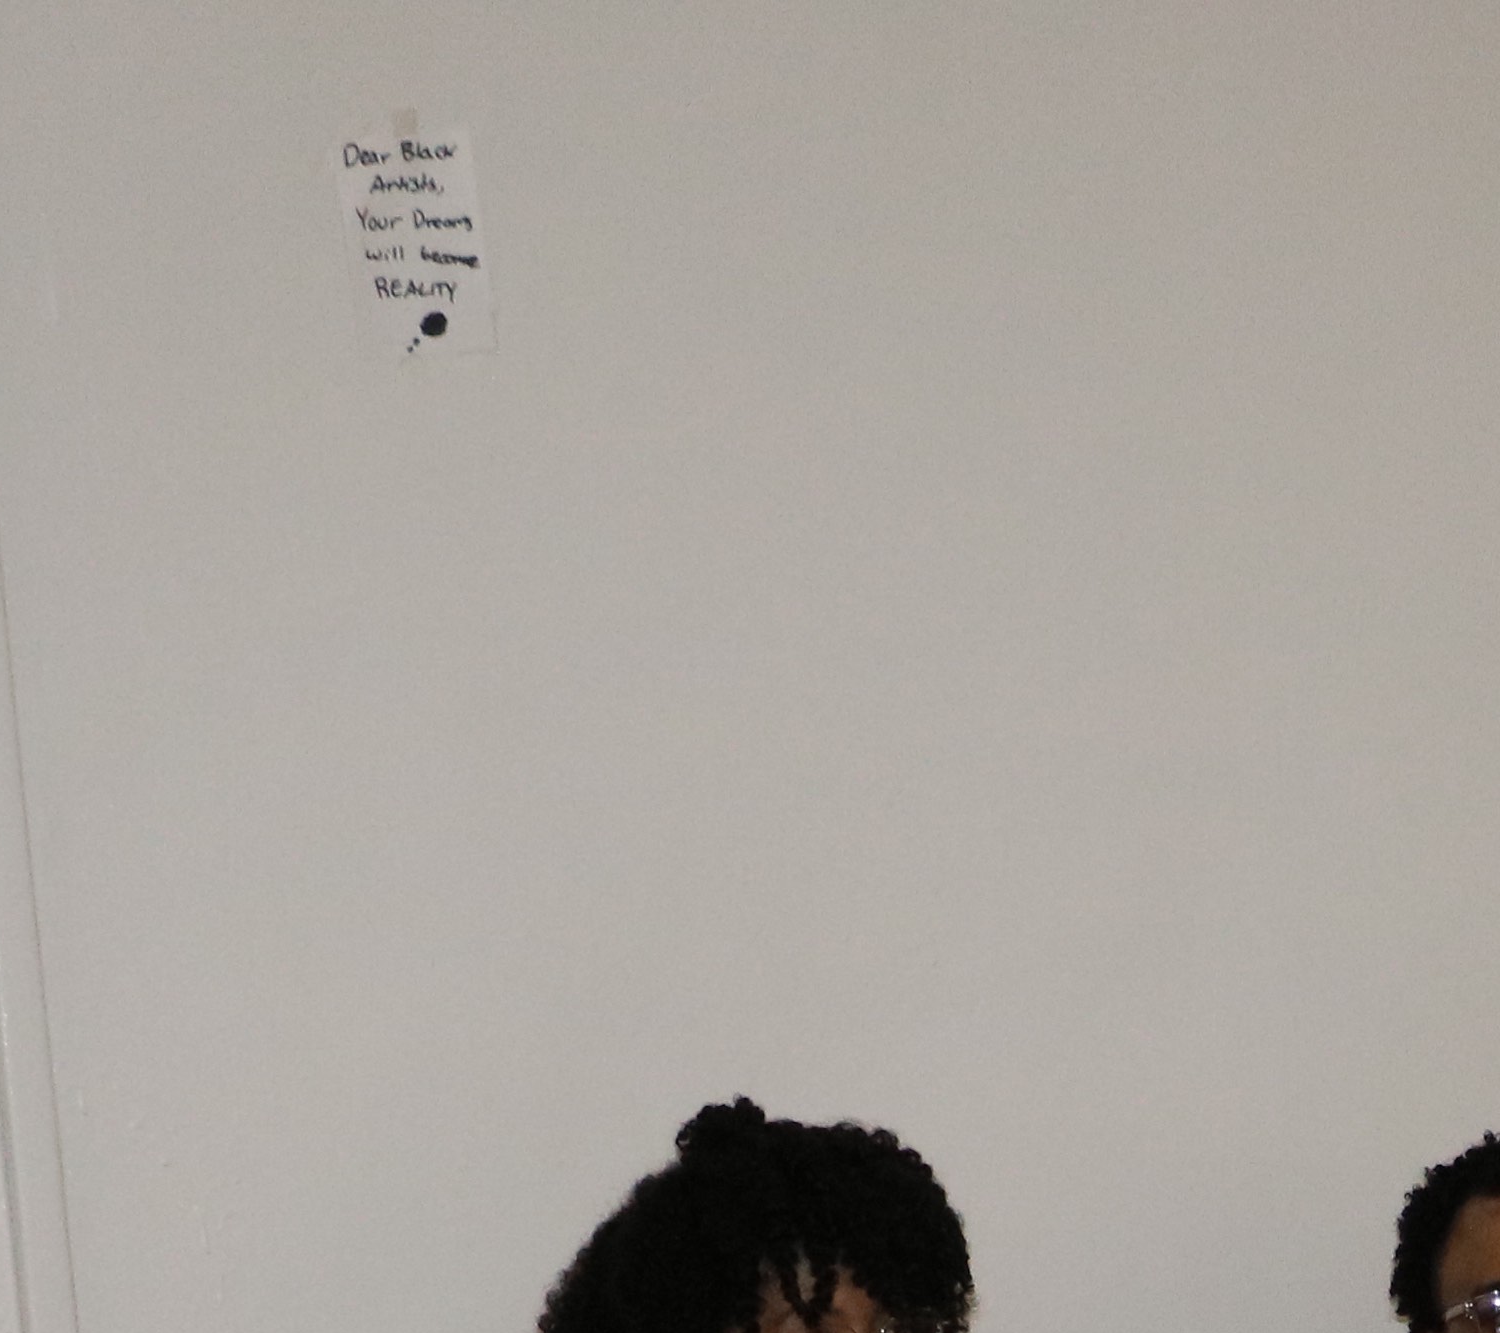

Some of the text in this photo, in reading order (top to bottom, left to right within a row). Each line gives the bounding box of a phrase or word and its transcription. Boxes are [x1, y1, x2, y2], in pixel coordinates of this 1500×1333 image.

[343, 143, 391, 168] Dear
[356, 205, 403, 233] Your
[365, 245, 404, 263] will
[375, 275, 458, 303] REALITY
